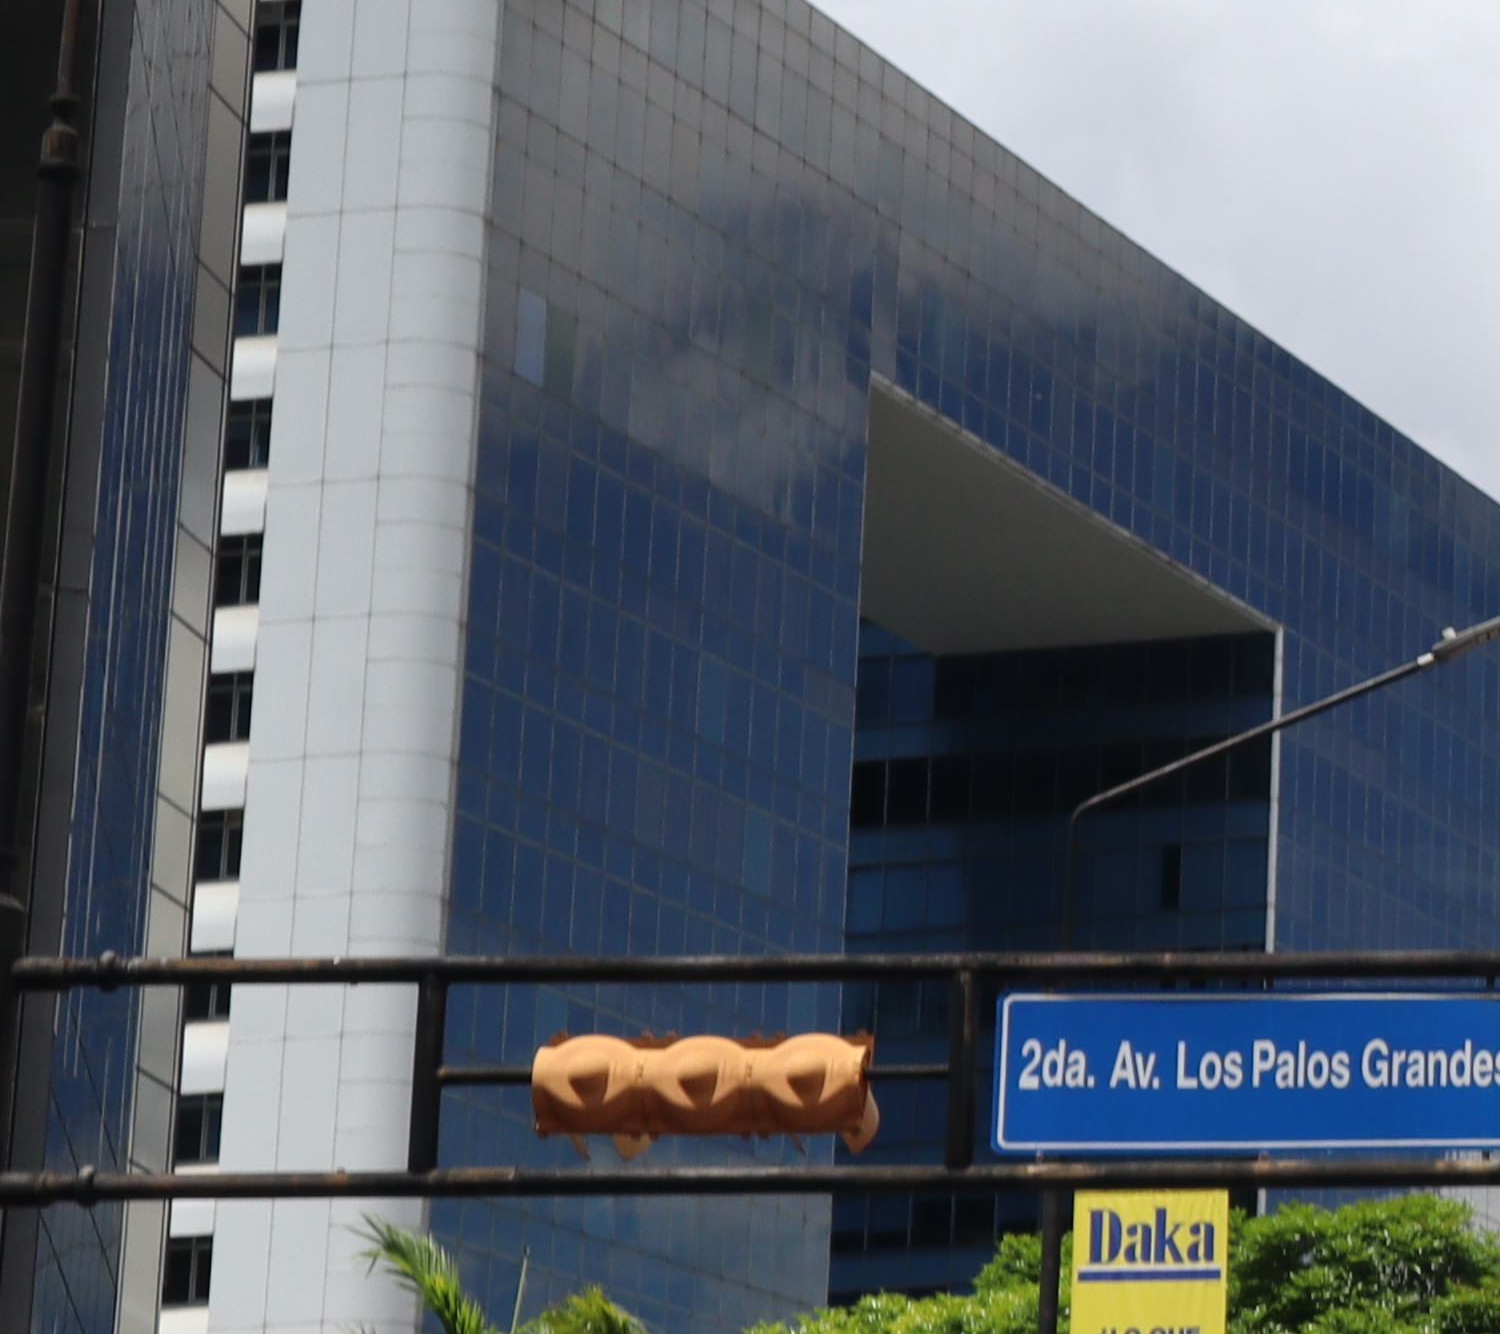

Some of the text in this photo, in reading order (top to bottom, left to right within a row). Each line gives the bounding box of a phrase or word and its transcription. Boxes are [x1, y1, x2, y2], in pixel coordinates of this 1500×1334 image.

[1018, 1038, 1095, 1090] 2da.
[1109, 1040, 1160, 1089] Av.
[1176, 1040, 1243, 1090] Los
[1252, 1039, 1350, 1088] Palos
[1087, 1208, 1215, 1266] Daka
